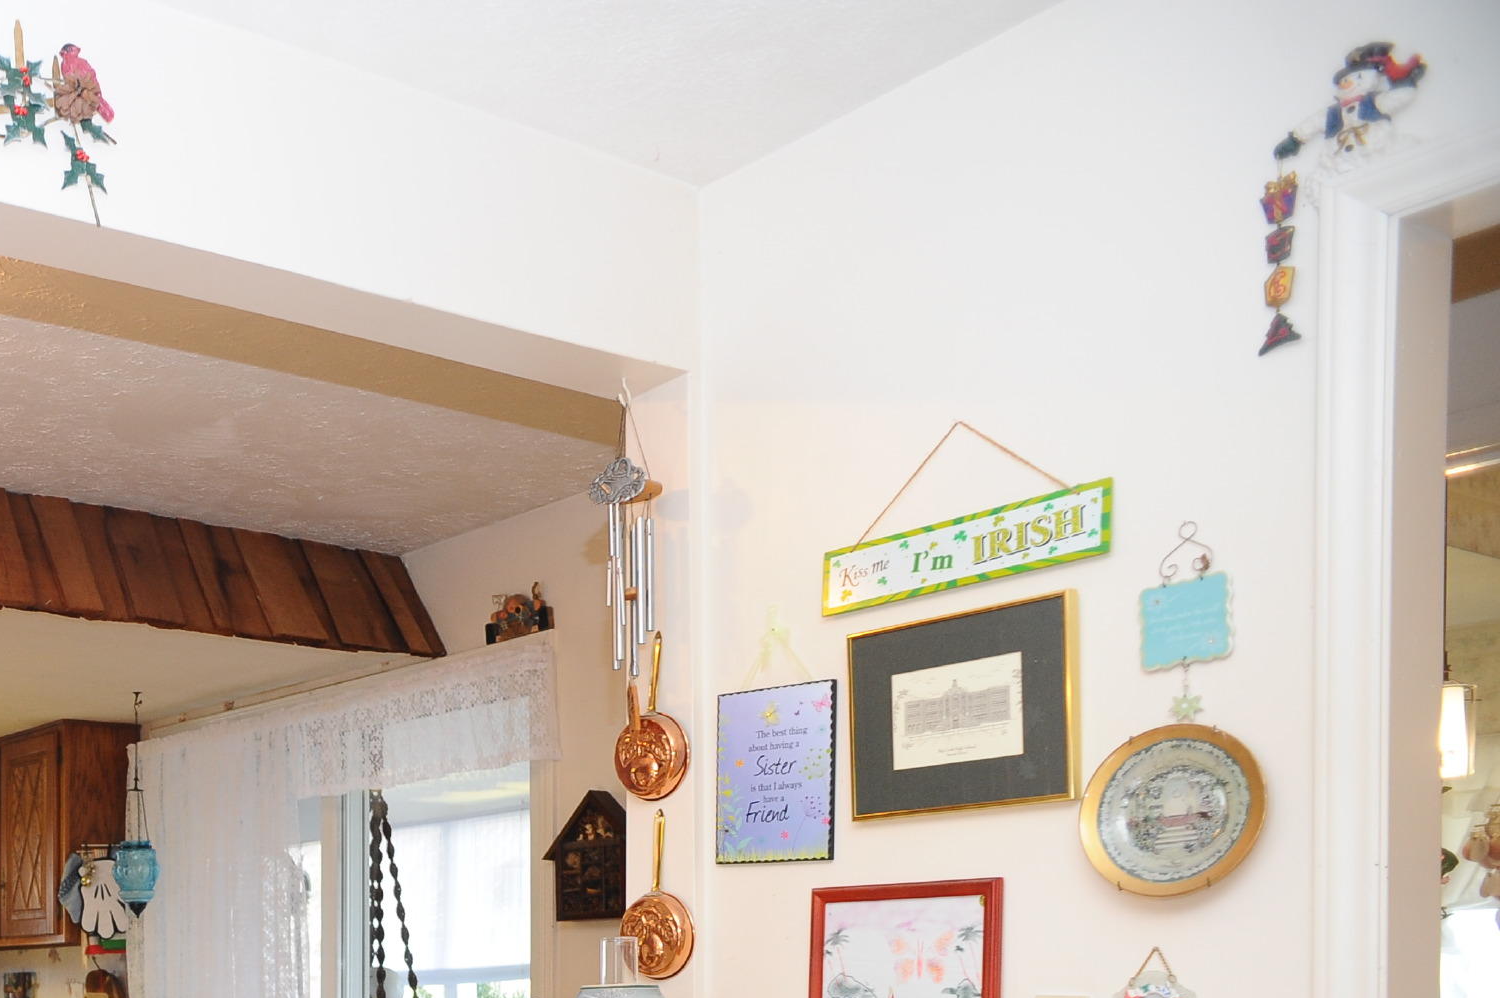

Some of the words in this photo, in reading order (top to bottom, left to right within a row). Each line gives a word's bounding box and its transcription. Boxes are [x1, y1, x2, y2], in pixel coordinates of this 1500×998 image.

[838, 565, 868, 587] Kiss
[910, 550, 954, 573] I'm
[970, 503, 1086, 567] IRISH
[756, 730, 771, 739] The
[772, 728, 787, 737] best
[788, 726, 808, 736] thing
[748, 743, 768, 752] about
[770, 741, 793, 751] having
[753, 755, 796, 776] Sister
[750, 784, 756, 792] is
[758, 783, 772, 792] that
[777, 782, 802, 791] always
[763, 795, 778, 803] have
[746, 801, 790, 823] Friend
